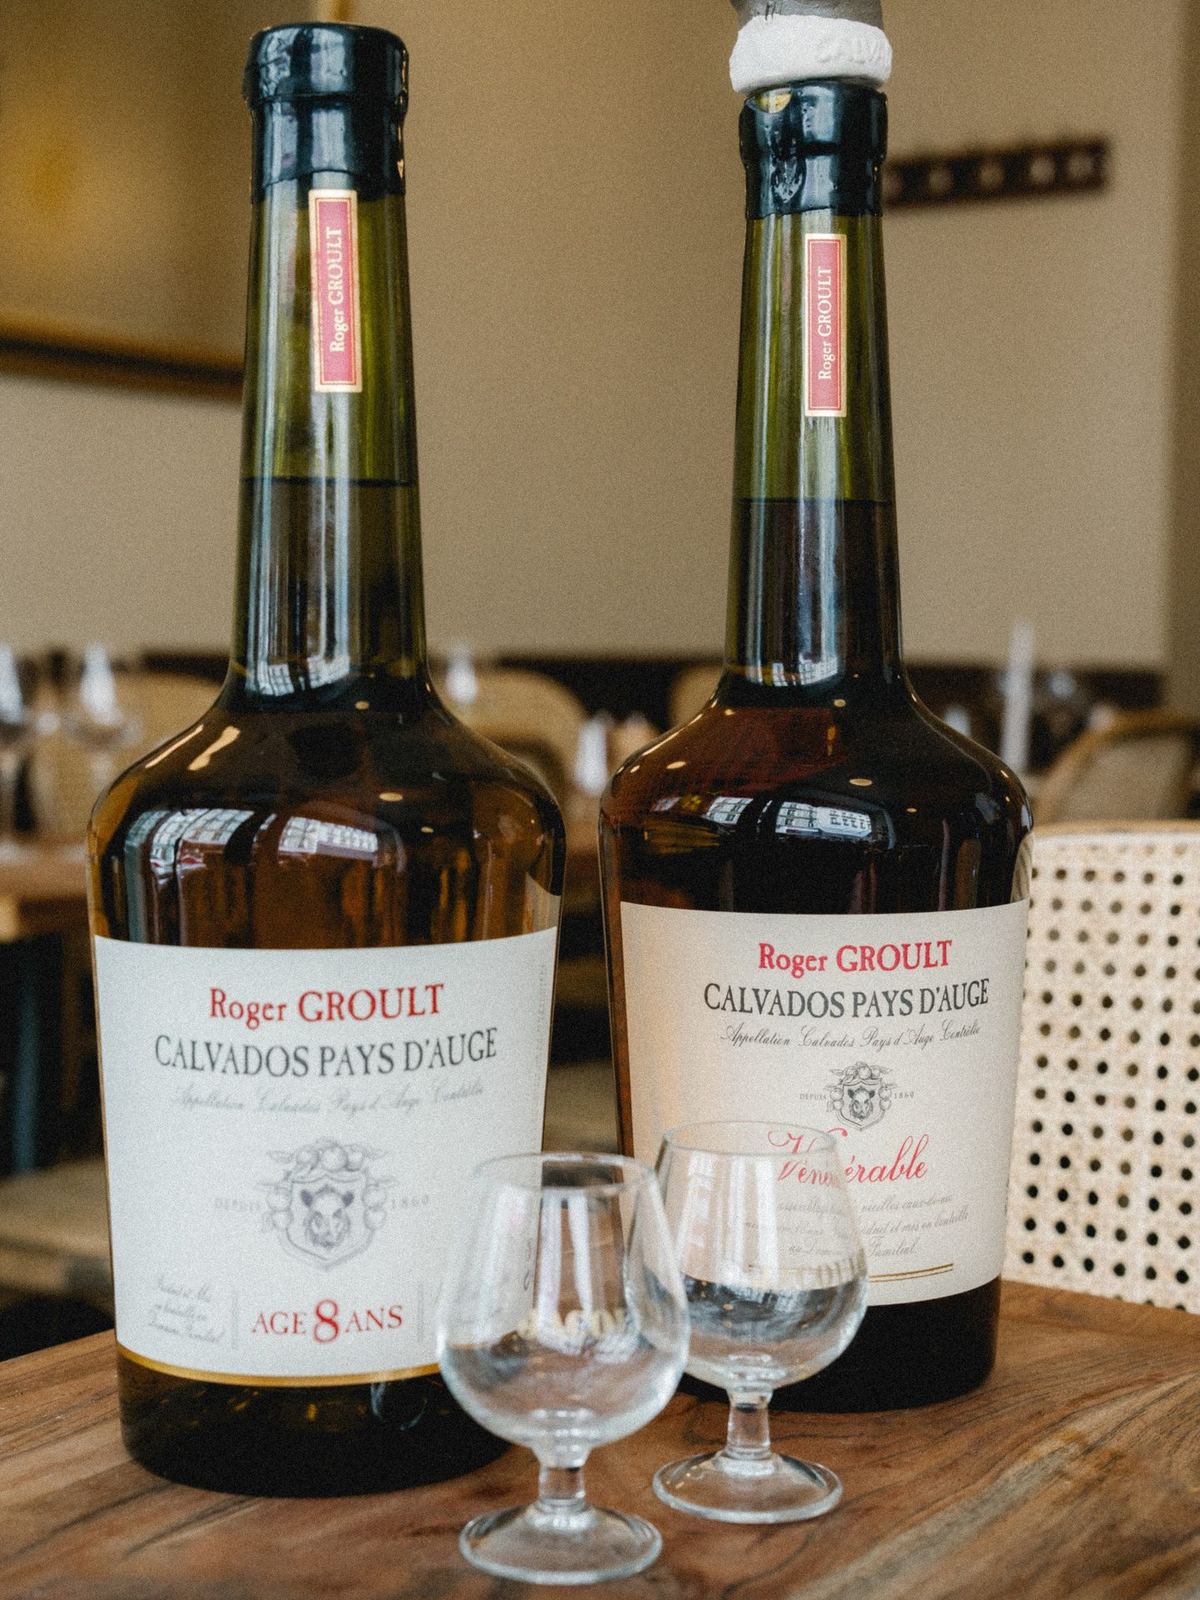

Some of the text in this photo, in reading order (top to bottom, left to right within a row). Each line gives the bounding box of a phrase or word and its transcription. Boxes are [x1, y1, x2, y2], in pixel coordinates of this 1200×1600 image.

[326, 226, 349, 353] Roger GROULT
[817, 265, 836, 381] Roger GROULT
[757, 939, 953, 979] Roger GROULT
[208, 983, 444, 1030] Roger GROULT
[703, 978, 990, 1019] CALVADOS PAYS D'AUGE
[155, 1027, 498, 1077] CALVADOS PAYS D'AUGE
[720, 1021, 791, 1048] Appellation
[799, 1025, 855, 1048] Calvados
[860, 1029, 892, 1052] Pays
[799, 1092, 827, 1101] DEPUIS
[251, 1310, 307, 1336] AGE
[312, 1298, 340, 1344] 8
[344, 1304, 405, 1334] ANS
